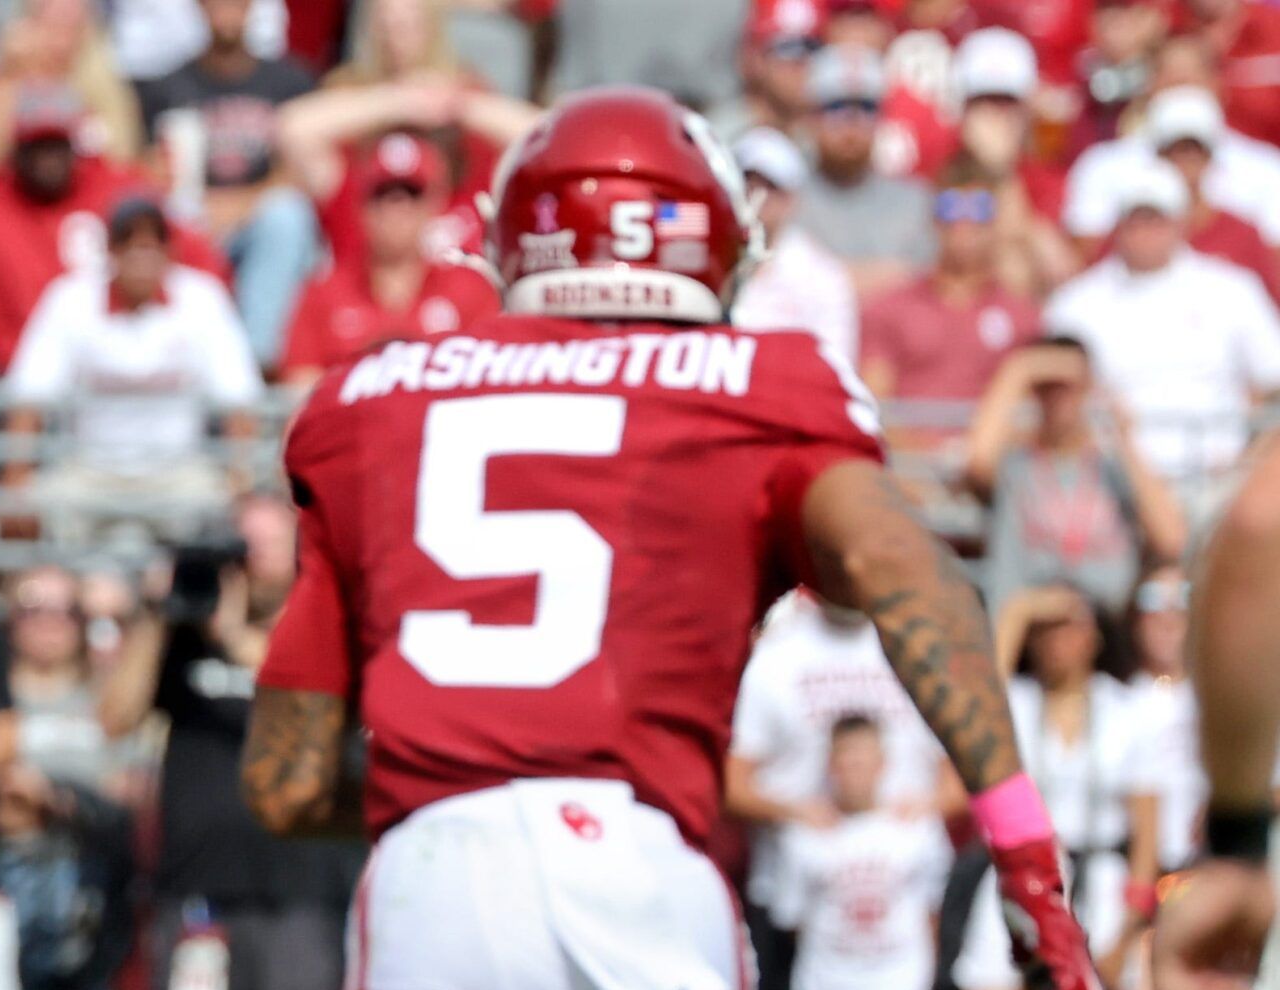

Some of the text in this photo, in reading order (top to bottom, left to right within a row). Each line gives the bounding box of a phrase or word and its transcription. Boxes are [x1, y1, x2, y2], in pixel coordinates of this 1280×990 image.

[610, 200, 655, 260] 5
[338, 331, 757, 405] WASHINGTON
[398, 393, 627, 688] 5
